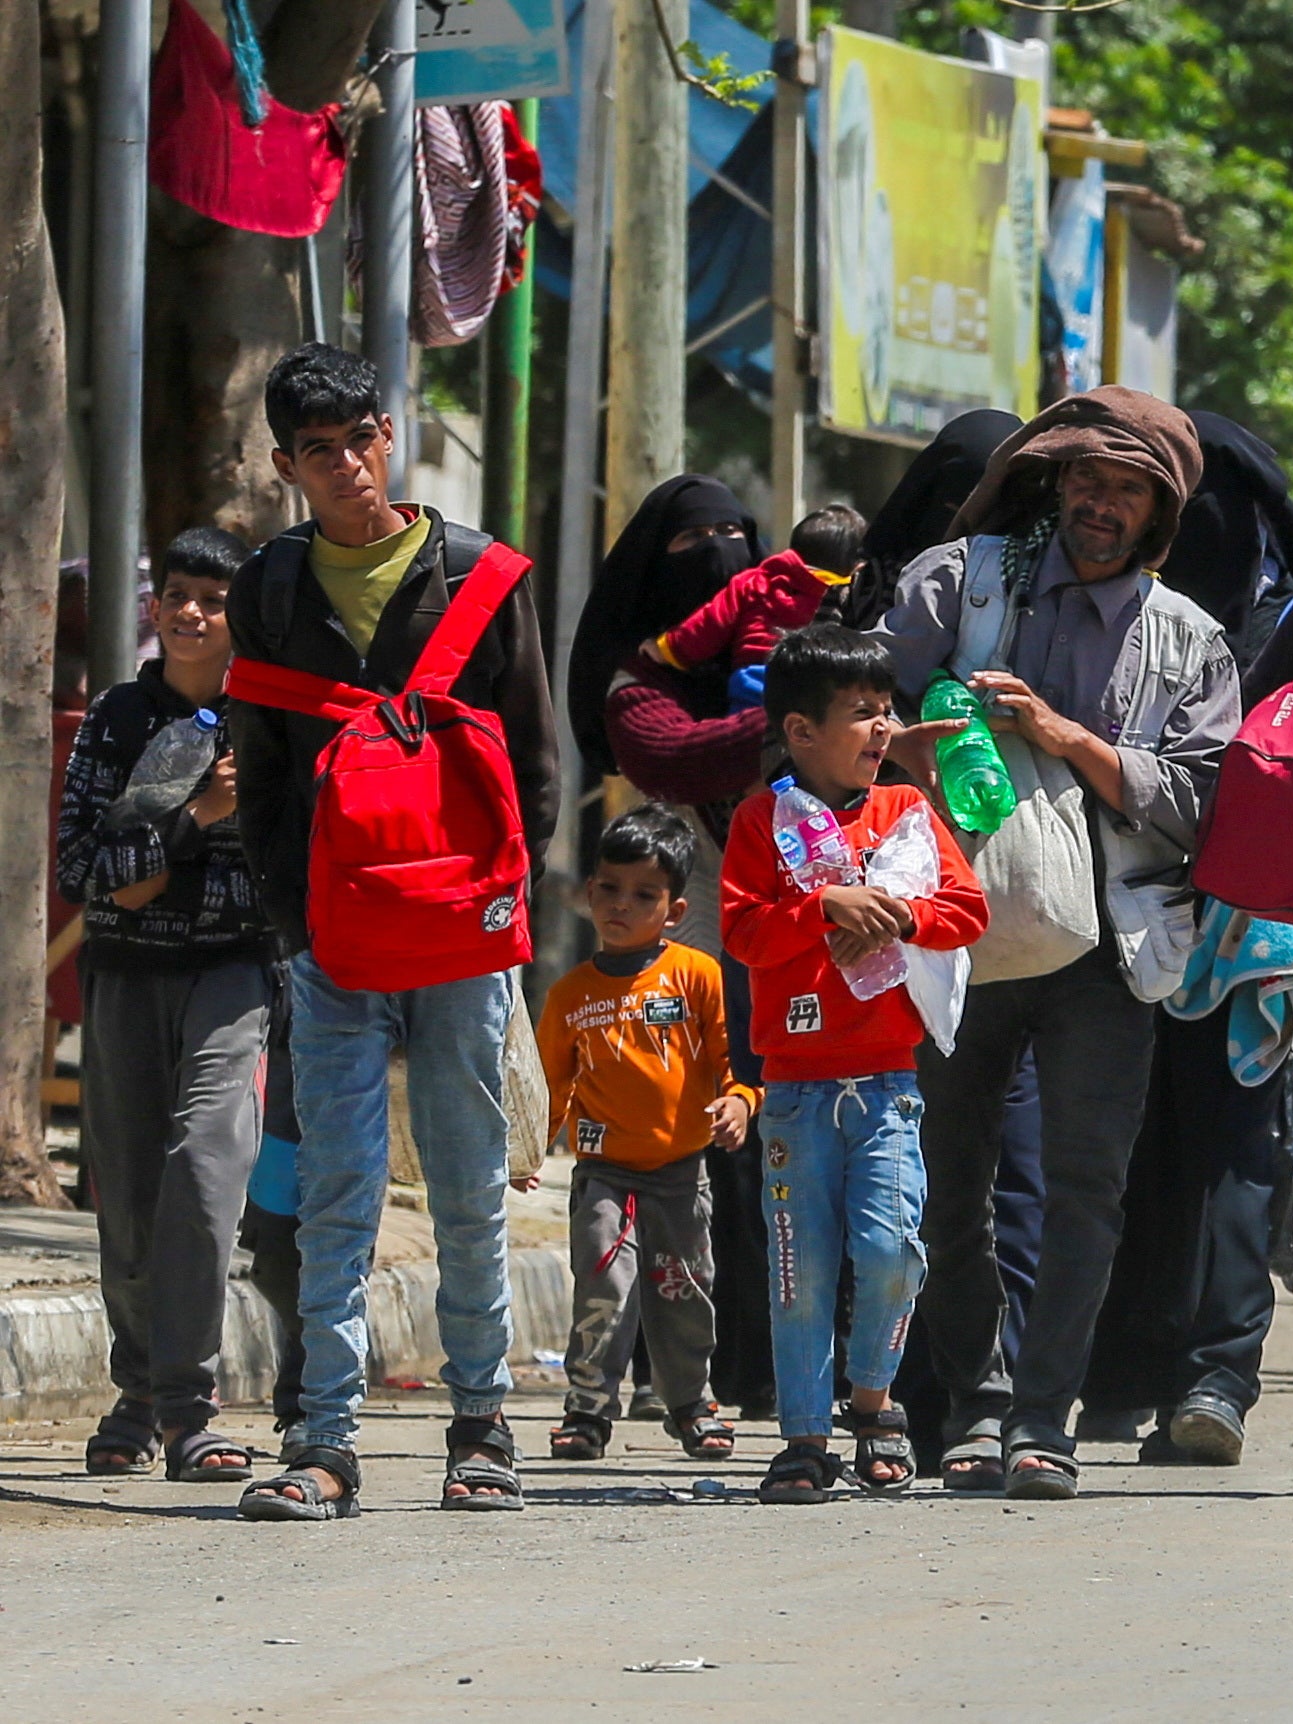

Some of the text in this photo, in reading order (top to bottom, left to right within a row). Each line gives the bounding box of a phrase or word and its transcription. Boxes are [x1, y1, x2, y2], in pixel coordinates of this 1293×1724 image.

[565, 999, 617, 1028] FASHION
[621, 993, 639, 1008] BY
[576, 1014, 615, 1031] DESIGN
[618, 1008, 644, 1022] VOG
